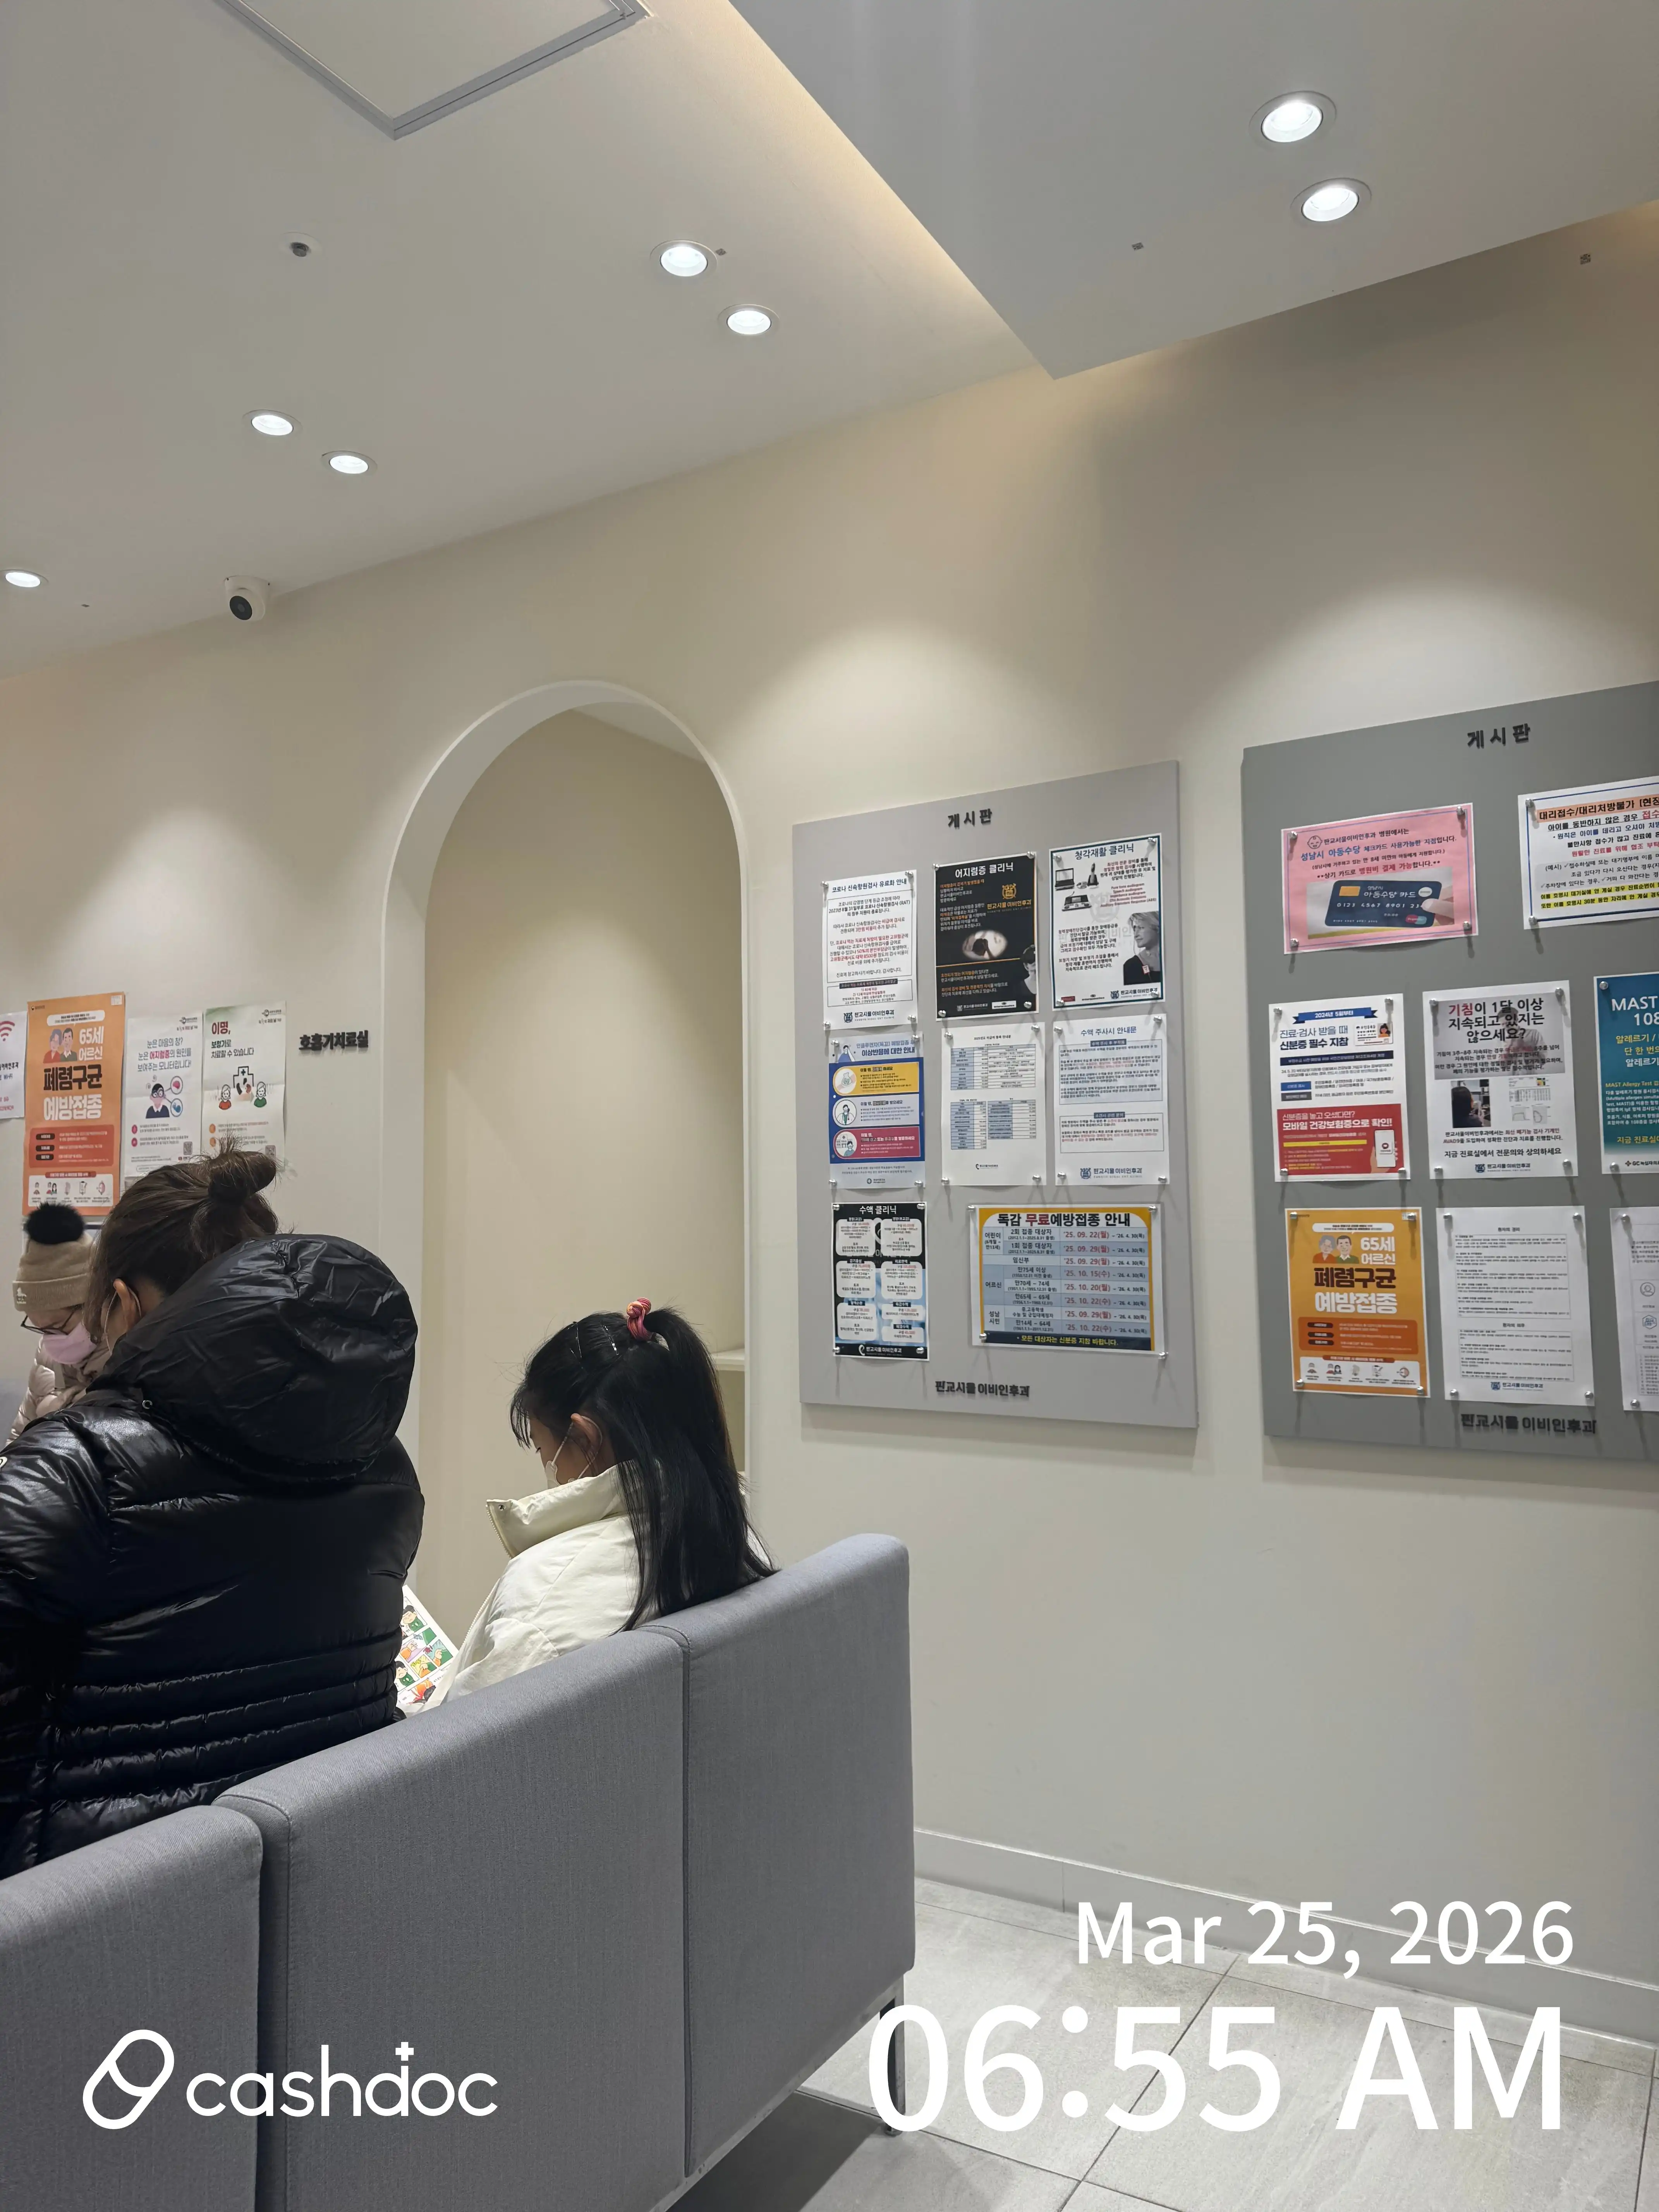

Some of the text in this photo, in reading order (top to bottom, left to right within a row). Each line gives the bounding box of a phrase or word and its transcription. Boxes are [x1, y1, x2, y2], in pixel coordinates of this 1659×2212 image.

[1467, 723, 1531, 749] 게시판
[948, 807, 993, 828] 게시판
[1540, 800, 1635, 820] 대리접수/대리처방불가
[1548, 823, 1568, 831] 아이를
[1573, 819, 1601, 828] 동반하지
[1324, 829, 1409, 845] 판교서울이비인후과 병원에서는
[1075, 843, 1134, 860] 청각재활 클리닉
[1301, 850, 1324, 861] 성남시
[1329, 845, 1360, 857] 아동수당
[1364, 843, 1387, 852] 체크카드
[1424, 835, 1456, 844] 지점입니다.
[955, 862, 1013, 878] 어지럼증 클리닉
[1359, 866, 1379, 874] 병원비
[848, 883, 878, 891] 신속항원검사
[1449, 998, 1544, 1016] 기침이 1달 이상
[1612, 996, 1658, 1011] MAST
[212, 1021, 230, 1034] 이명,
[1449, 1013, 1544, 1030] 지속되고 있지는
[79, 1026, 104, 1044] 65세
[1319, 1027, 1336, 1036] 받을
[1340, 1026, 1348, 1034] 때
[1467, 1028, 1526, 1043] 않으세요?
[148, 1037, 183, 1049] 눈은 마음의 창?
[211, 1039, 231, 1048] 보청기로
[299, 1030, 368, 1051] 호흡기치료실
[1280, 1037, 1348, 1050] 신분증 필수 지참
[1616, 1034, 1649, 1044] 알레르기
[79, 1046, 102, 1061] 어르신
[139, 1052, 148, 1061] 눈은
[150, 1049, 175, 1060] 어지럼증의
[234, 1048, 254, 1056] 있습니다
[1625, 1047, 1632, 1055] 단
[138, 1063, 158, 1072] 보여주는
[43, 1064, 102, 1091] 폐렴구균
[43, 1094, 102, 1120] 예방접종
[1283, 1118, 1392, 1130] 모바일 건강보험증으로 확인!
[859, 1205, 897, 1214] 수액 클리닉
[998, 1213, 1130, 1226] 독감 무료예방접종 안내
[1090, 1245, 1109, 1253] 29(월)
[1360, 1237, 1395, 1252] 65세
[1361, 1254, 1396, 1265] 어르신
[1314, 1267, 1396, 1288] 폐렴구균
[1315, 1292, 1397, 1314] 예방접종
[935, 1381, 1030, 1397] 판교서울 이비인후과
[1461, 1413, 1596, 1434] 판교서울 이비인후과
